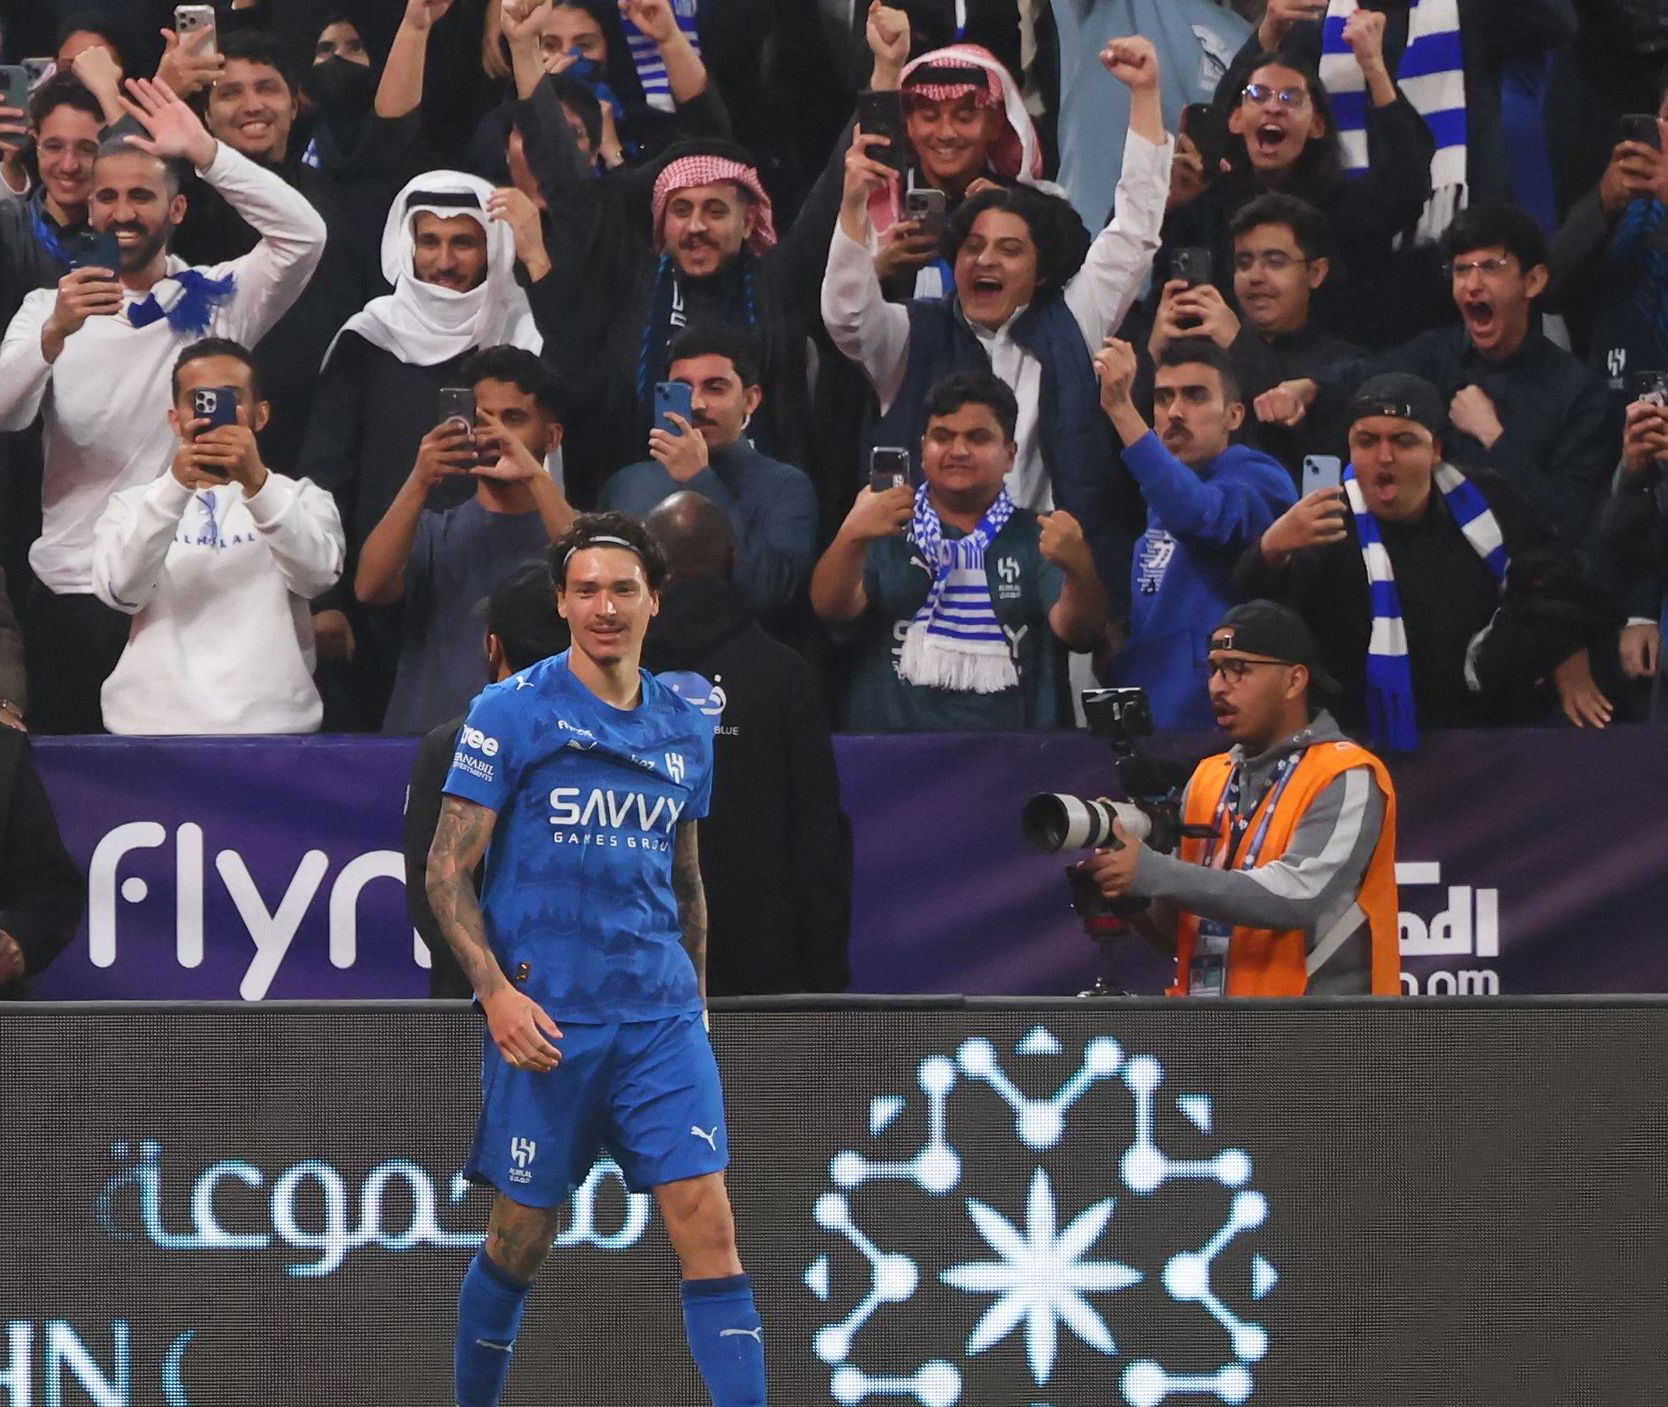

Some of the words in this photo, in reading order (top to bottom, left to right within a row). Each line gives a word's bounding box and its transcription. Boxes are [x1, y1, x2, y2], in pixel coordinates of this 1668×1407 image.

[549, 786, 685, 834] SAVVY
[553, 830, 618, 848] GAMES
[626, 833, 670, 852] GROU
[89, 821, 432, 1003] flyn
